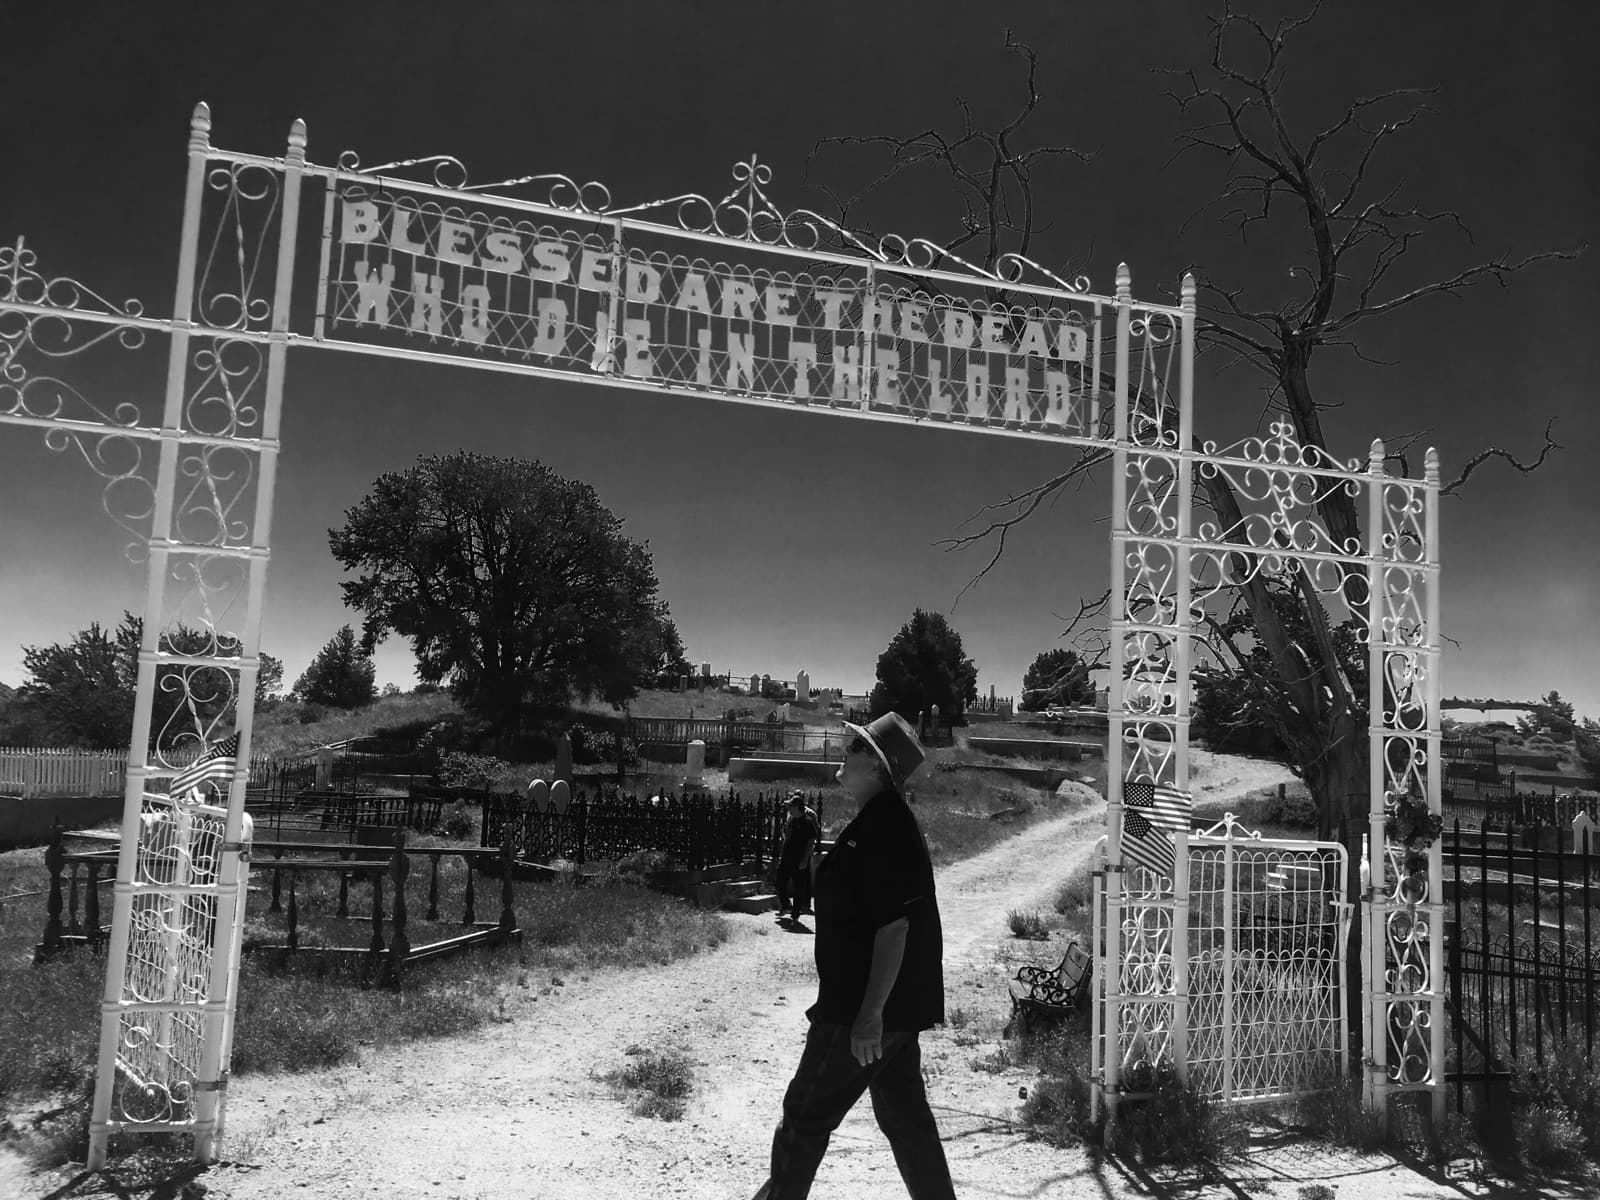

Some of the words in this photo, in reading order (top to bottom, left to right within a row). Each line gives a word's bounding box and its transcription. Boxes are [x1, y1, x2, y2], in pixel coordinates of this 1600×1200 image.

[340, 200, 661, 304] BLESSED
[675, 273, 798, 326] ARE
[814, 290, 930, 343] THE
[944, 308, 1088, 361] DEAD
[353, 260, 491, 345] WHO
[532, 297, 653, 376] DIE
[697, 328, 756, 390] IN
[788, 341, 900, 404] THE
[928, 358, 1071, 424] LORD
